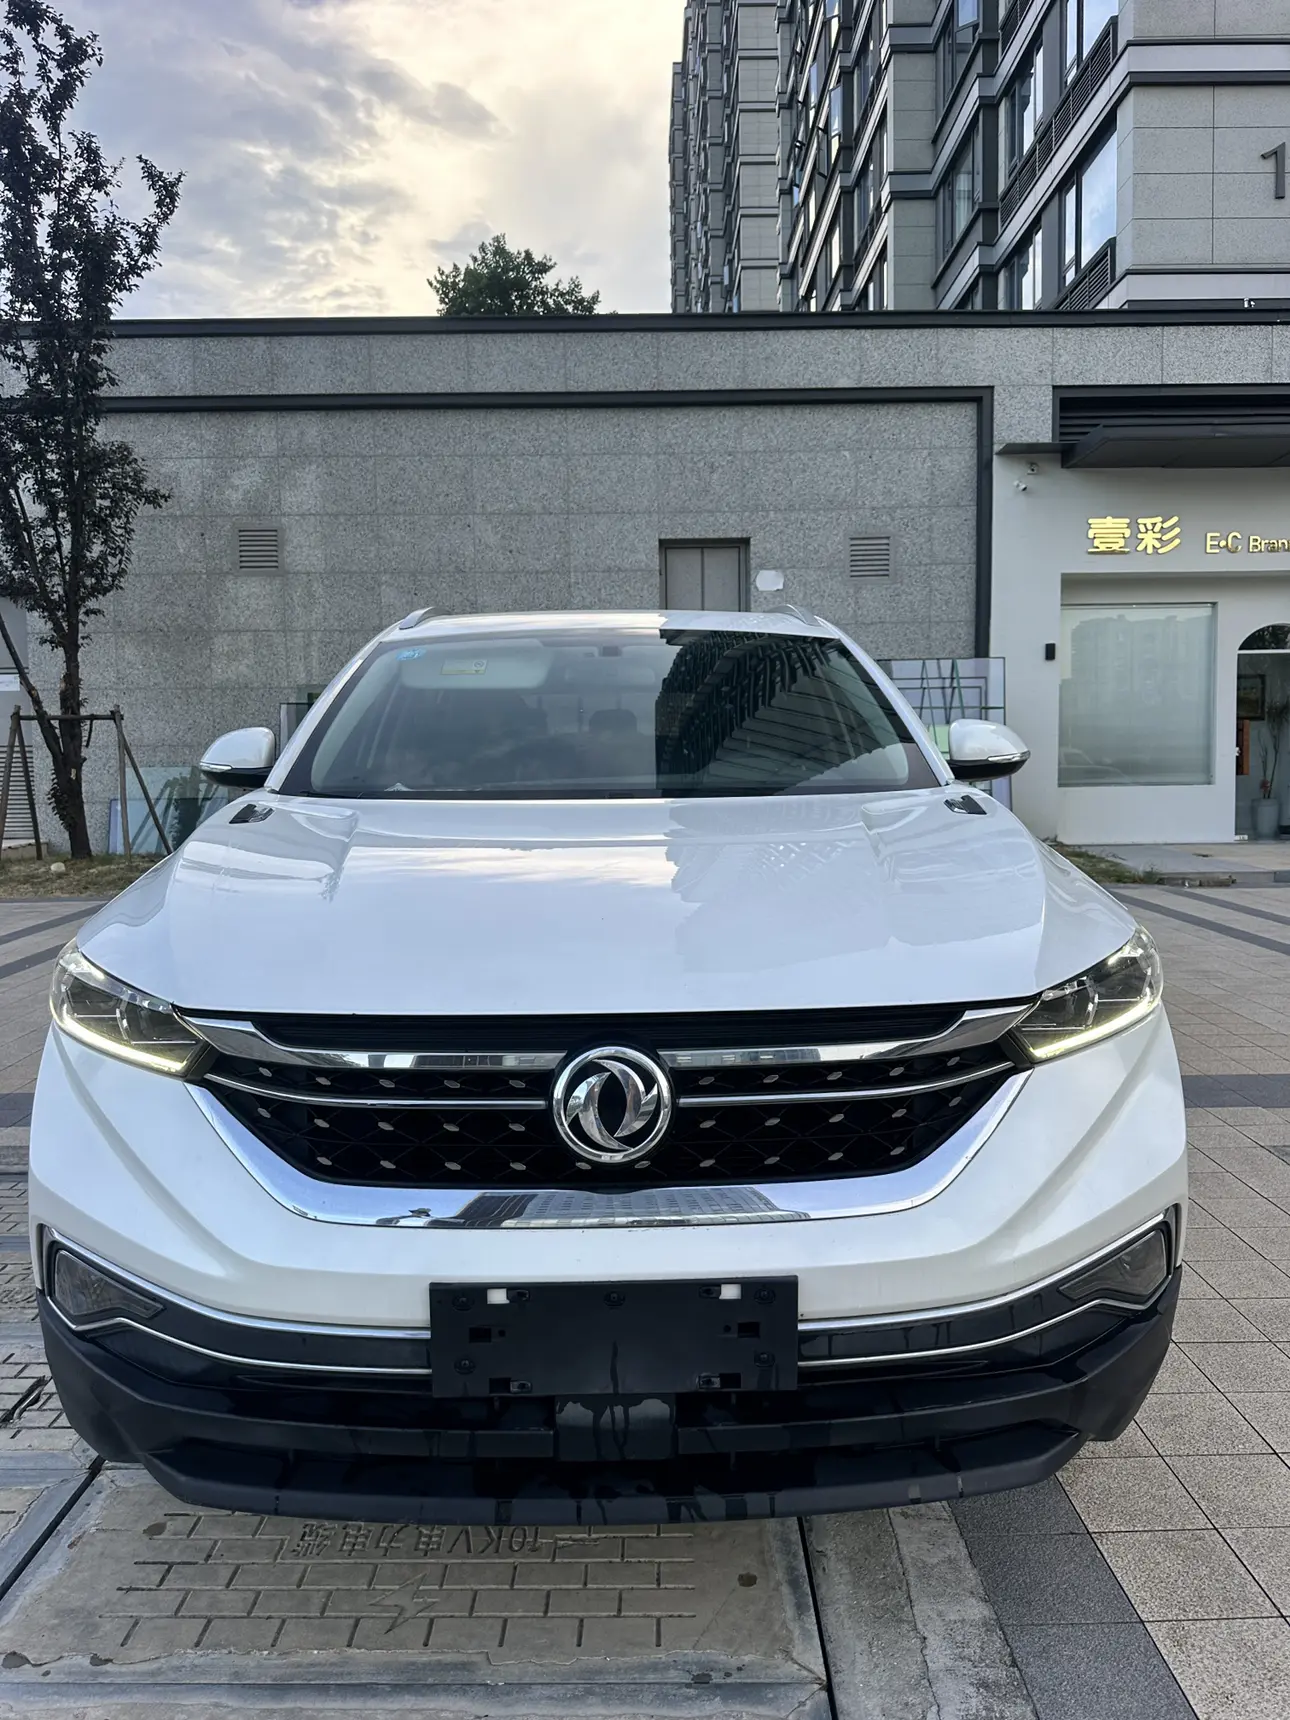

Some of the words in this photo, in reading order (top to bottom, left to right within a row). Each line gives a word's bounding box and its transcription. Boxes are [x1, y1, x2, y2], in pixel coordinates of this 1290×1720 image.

[1260, 142, 1286, 199] 1
[1087, 516, 1181, 554] 壹彩
[1248, 535, 1290, 553] Bran
